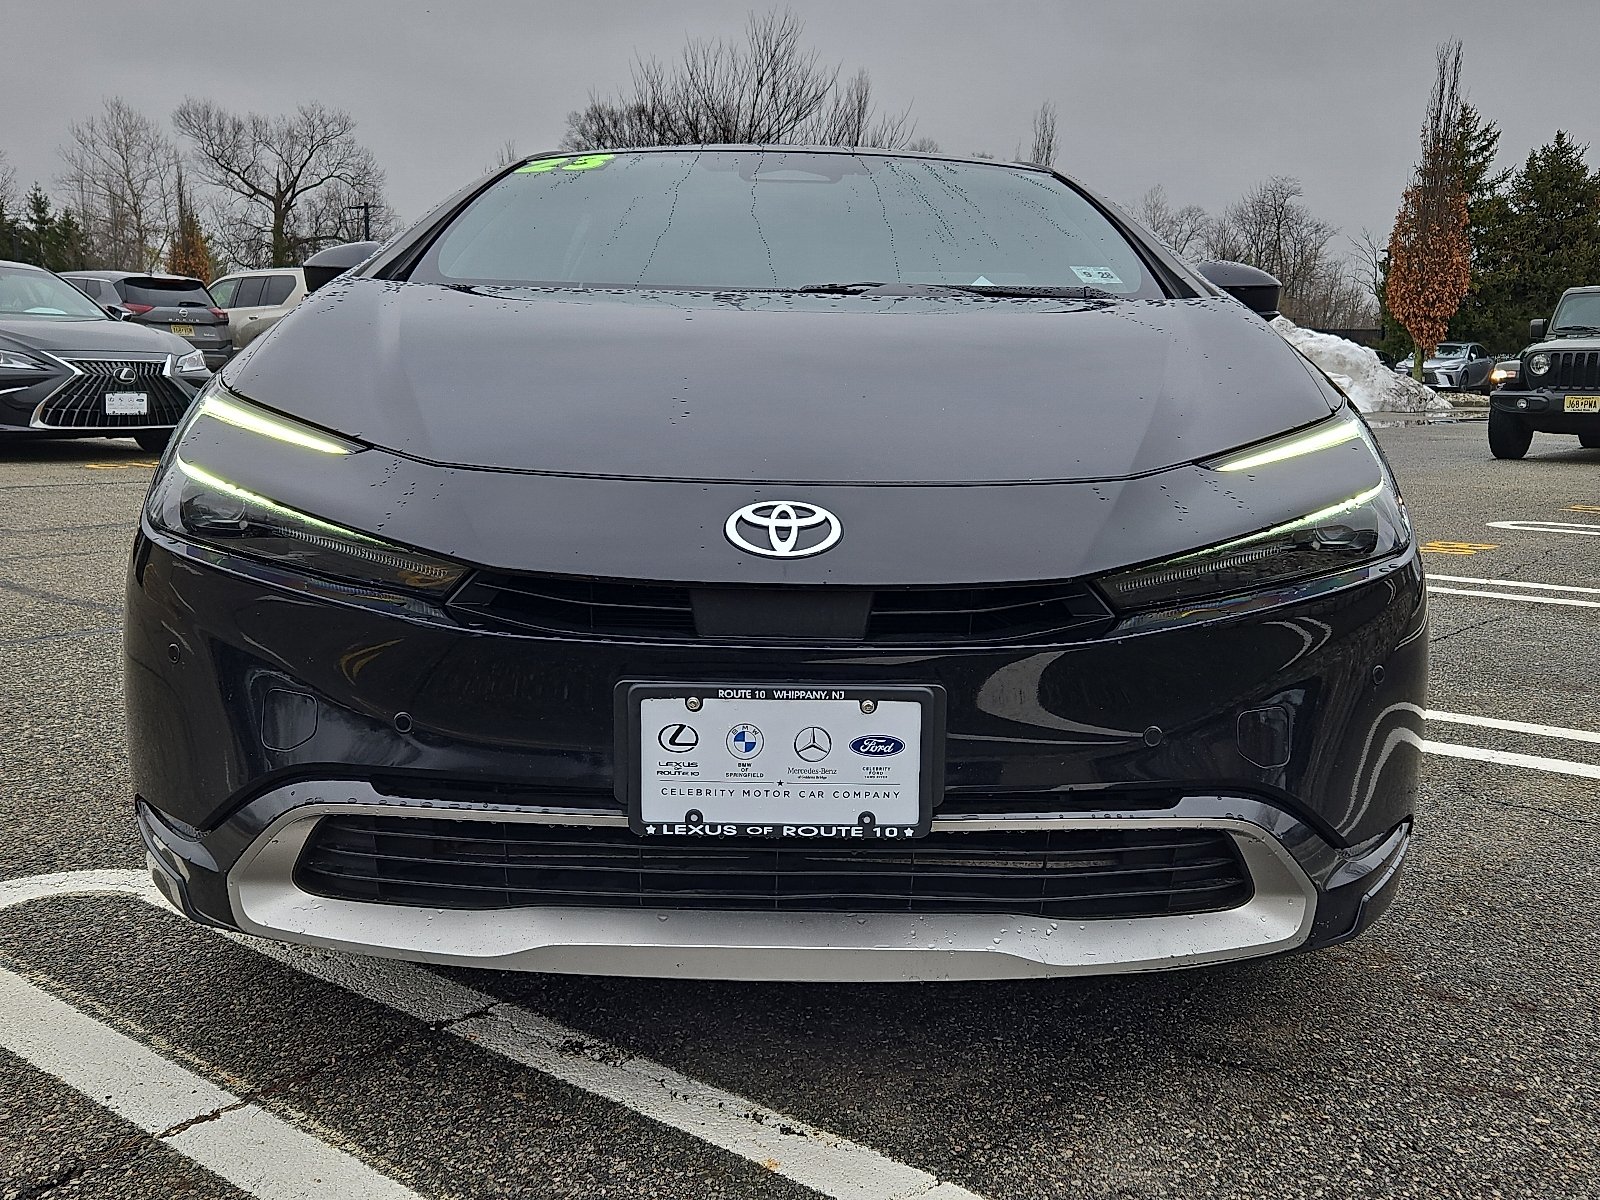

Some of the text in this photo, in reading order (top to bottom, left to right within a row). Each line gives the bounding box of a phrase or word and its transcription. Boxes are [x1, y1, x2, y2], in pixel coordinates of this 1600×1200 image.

[718, 689, 845, 700] ROUTE 10 WHIPPANY, NJ
[731, 725, 759, 736] BMW
[859, 738, 895, 753] Ford
[787, 766, 838, 775] Mercedes-Benz
[661, 787, 901, 799] CELEBRITY MOTOR CAR COMPANY
[662, 823, 899, 838] LEXUS OF ROUTE 10
